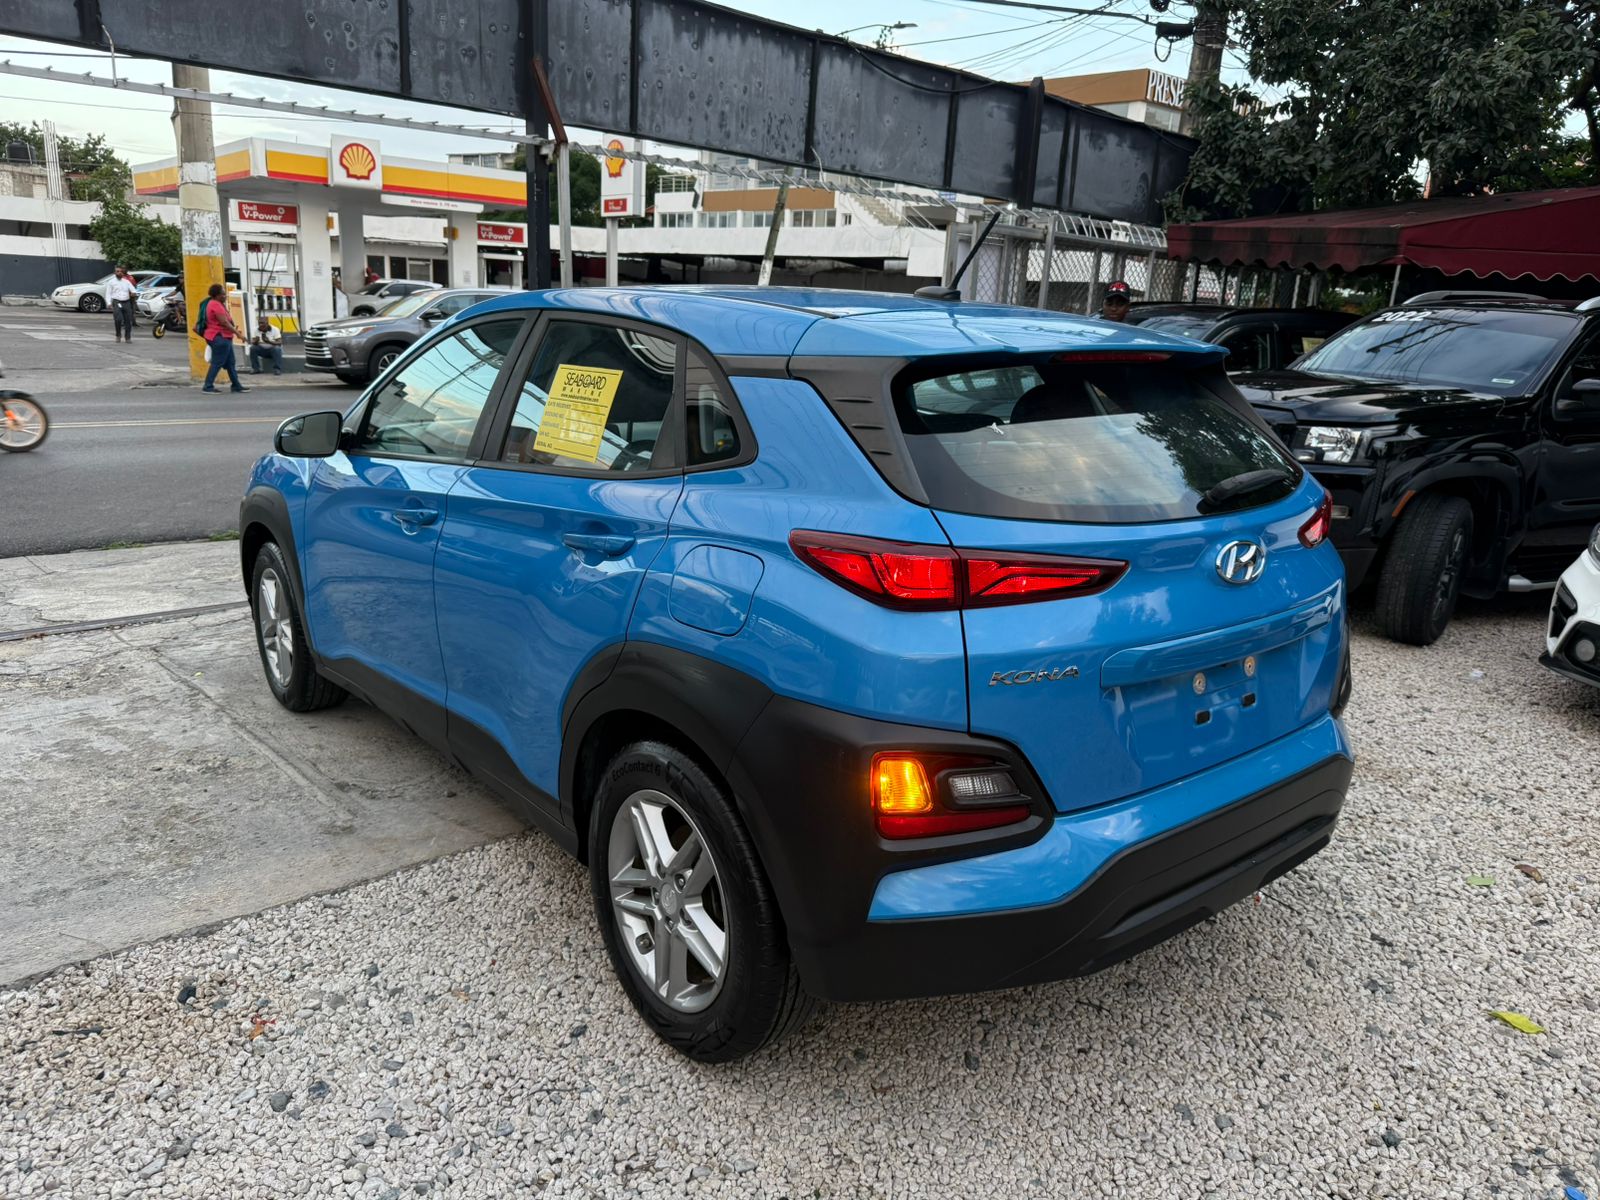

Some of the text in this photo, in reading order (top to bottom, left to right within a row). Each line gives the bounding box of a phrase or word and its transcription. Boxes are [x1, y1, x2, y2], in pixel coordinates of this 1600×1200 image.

[242, 210, 283, 221] V-Power
[481, 231, 512, 241] V-Power
[1371, 311, 1432, 322] 2022
[564, 372, 607, 390] SEABOARD
[988, 665, 1079, 686] KONA
